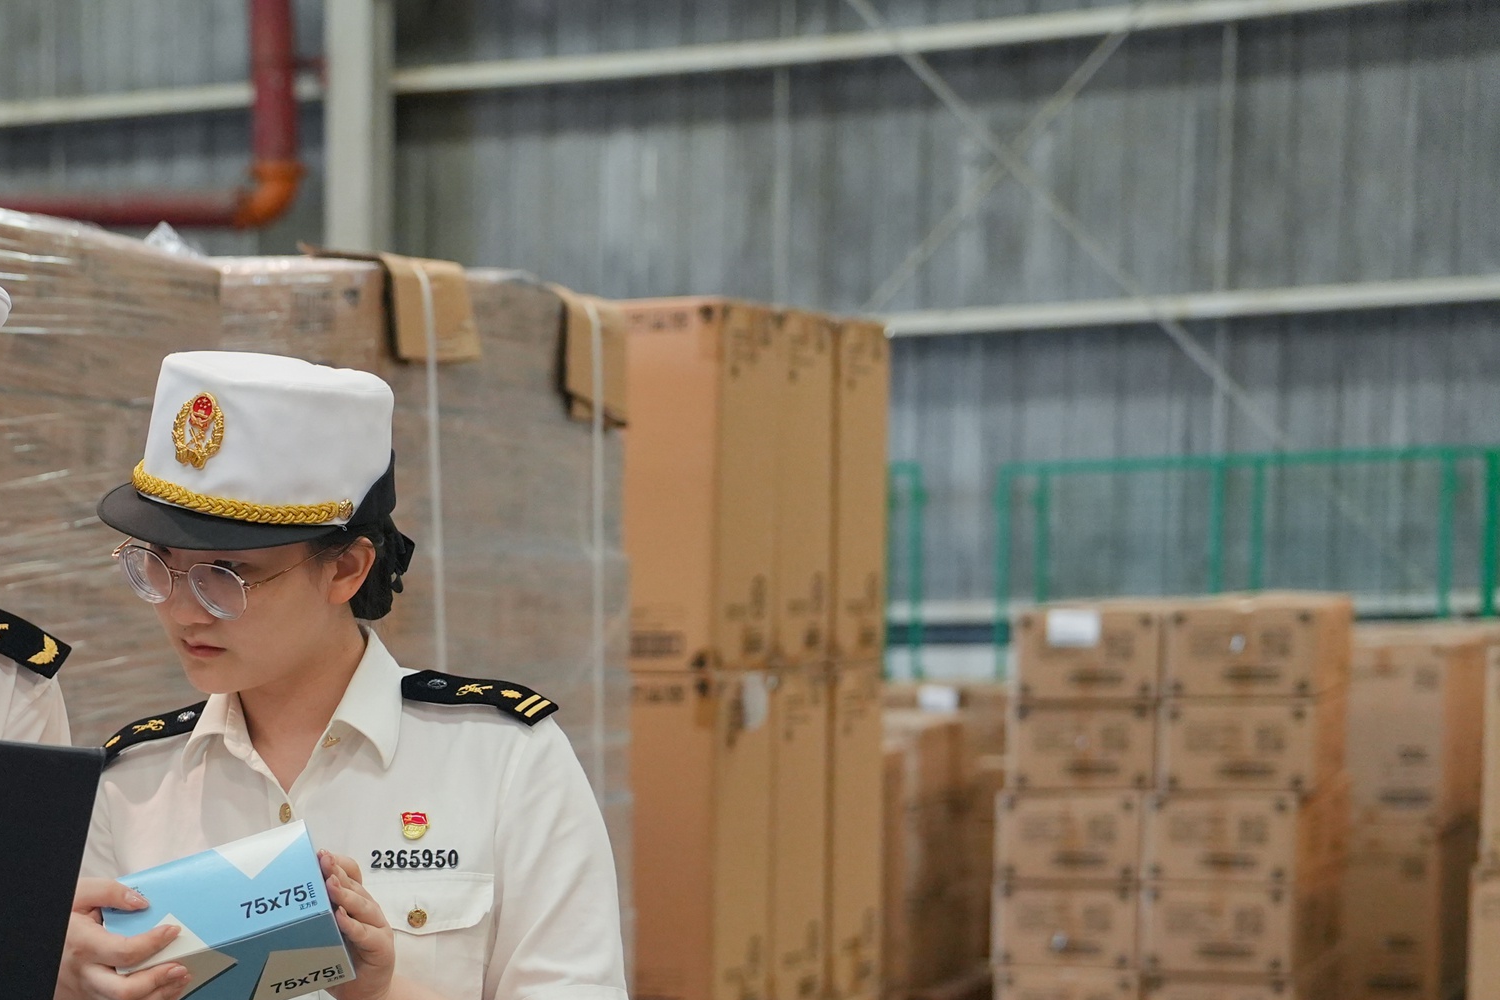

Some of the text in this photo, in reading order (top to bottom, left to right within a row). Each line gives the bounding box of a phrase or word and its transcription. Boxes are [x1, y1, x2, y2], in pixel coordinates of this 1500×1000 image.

[371, 849, 460, 870] 2365950
[240, 884, 308, 919] 75x75
[270, 965, 337, 994] 75x75
